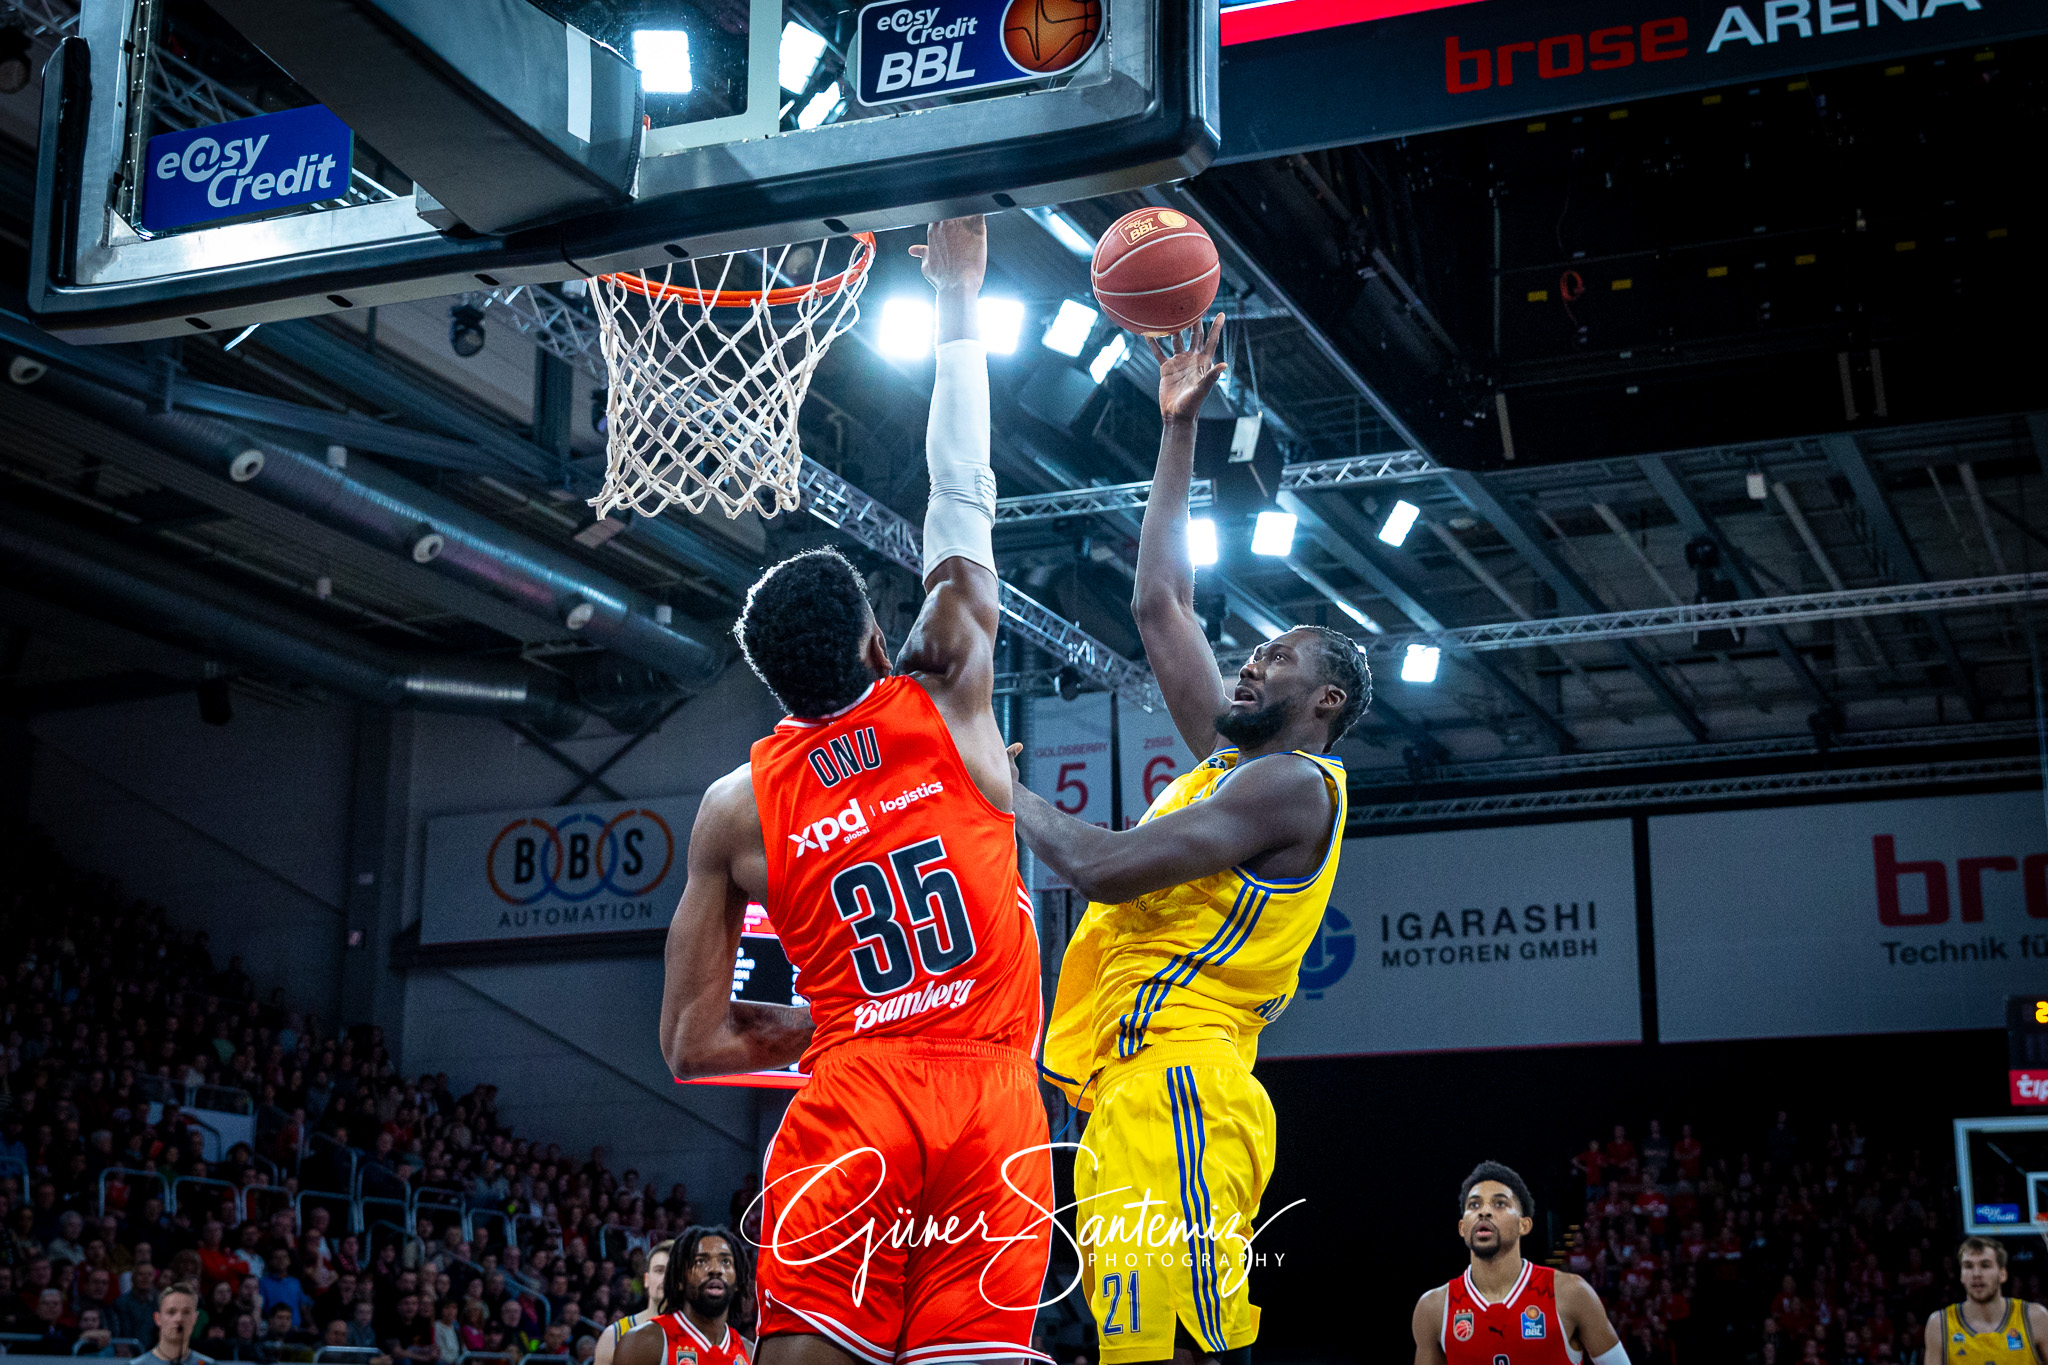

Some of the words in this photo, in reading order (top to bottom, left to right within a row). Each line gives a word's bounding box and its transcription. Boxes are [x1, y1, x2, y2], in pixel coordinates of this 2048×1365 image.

[906, 17, 978, 45] Credit
[1444, 16, 1688, 94] brose
[876, 41, 976, 93] BBL
[207, 154, 336, 208] Credit
[1129, 222, 1158, 241] BBL
[808, 726, 881, 788] ONU
[1142, 755, 1176, 806] 6
[1055, 762, 1088, 815] 5
[788, 798, 867, 858] xpd
[880, 781, 943, 813] logistics
[843, 825, 870, 844] global
[498, 902, 653, 929] AUTOMATION
[830, 835, 977, 997] 35
[1381, 901, 1597, 943] IGARASHI
[1382, 943, 1510, 968] MOTOREN
[1519, 938, 1598, 961] GMBH
[1880, 936, 2009, 967] Technik
[853, 978, 977, 1034] Bamberg
[1102, 1270, 1141, 1336] 21
